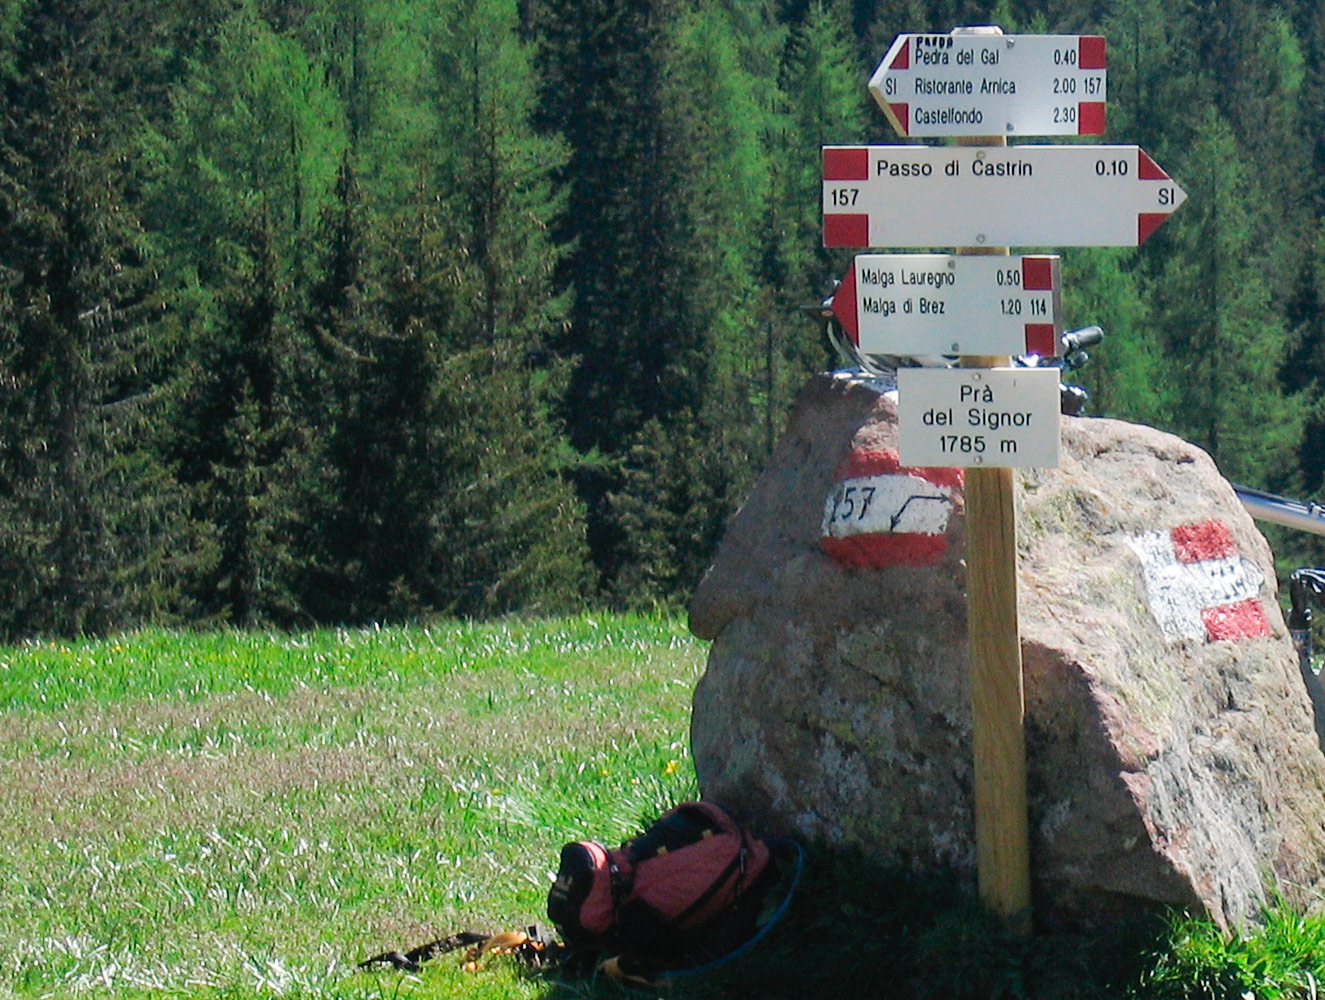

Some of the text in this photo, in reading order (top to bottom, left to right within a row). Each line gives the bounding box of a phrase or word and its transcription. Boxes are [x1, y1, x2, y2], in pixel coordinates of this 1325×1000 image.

[913, 47, 1077, 66] Pedra del Gal 0.40
[885, 77, 897, 96] SI
[914, 77, 1077, 95] Ristorante Arnica 2.00
[1084, 77, 1102, 95] 157
[914, 106, 1076, 125] Castelfondo 2.30
[877, 159, 1128, 177] Passo di Castrin 0.10
[831, 188, 859, 207] 157
[1158, 187, 1175, 206] SI
[861, 268, 1021, 289] Malga Lauregno 0.50
[863, 296, 1022, 318] Malga di Brez 1.20
[1030, 298, 1047, 316] 114
[960, 384, 994, 403] Prà
[922, 408, 1033, 431] del Signor
[939, 435, 1017, 453] 1785 m
